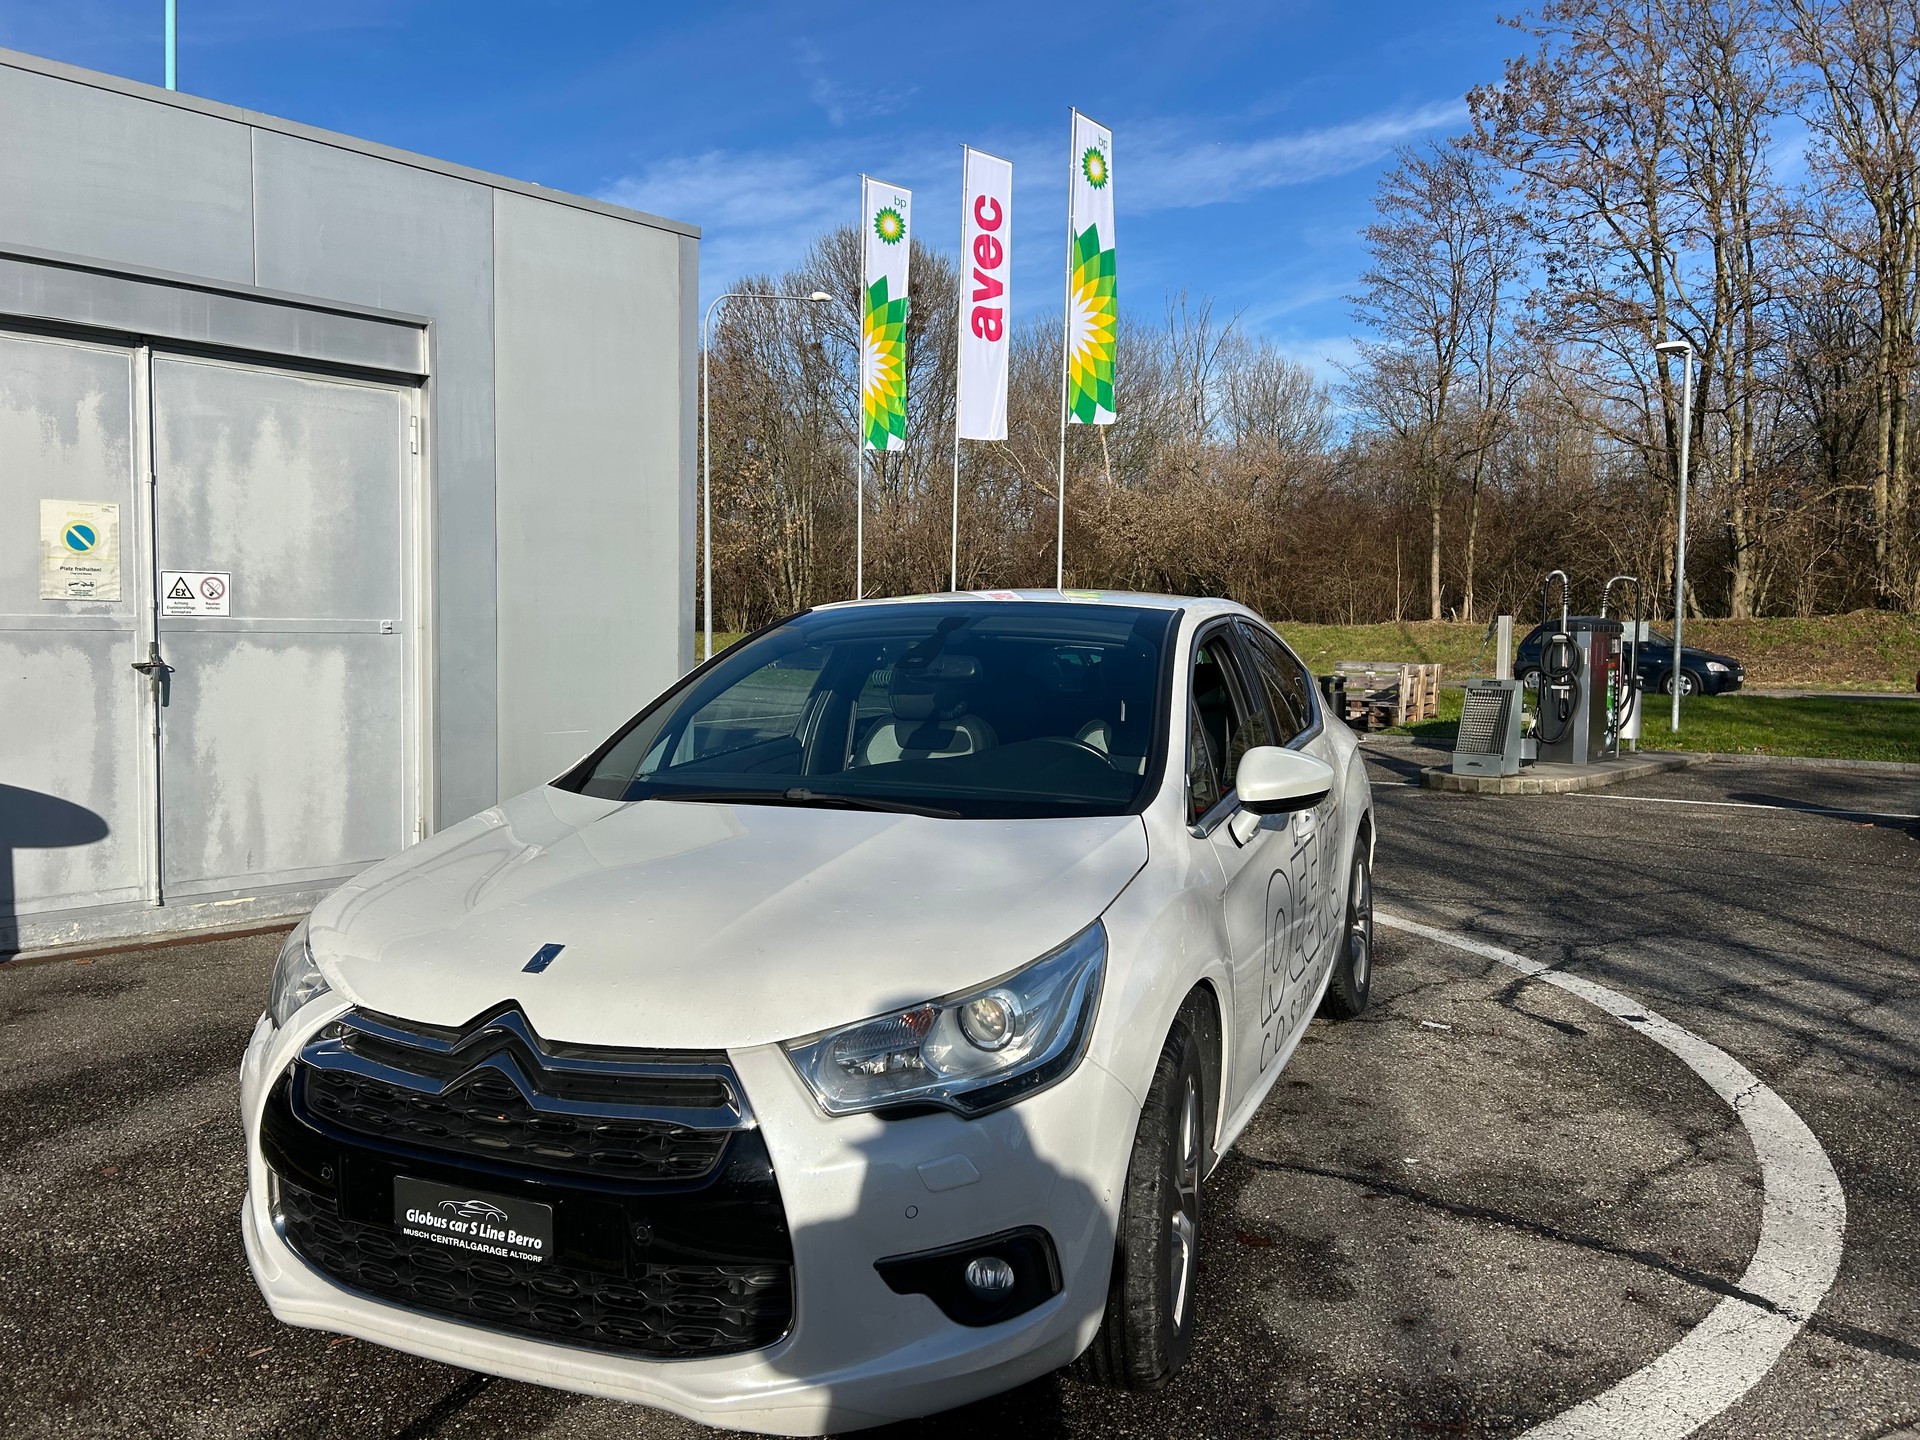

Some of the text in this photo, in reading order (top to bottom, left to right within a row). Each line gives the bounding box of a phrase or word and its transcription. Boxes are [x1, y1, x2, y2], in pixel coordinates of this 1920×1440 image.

[1098, 134, 1108, 150] bp
[893, 195, 907, 209] bp
[971, 194, 1004, 342] avec
[175, 588, 187, 597] EX
[406, 1208, 542, 1250] Globus car S Line Berro
[403, 1227, 543, 1263] MUSCH CENTRALGARAGE ALTDORF
